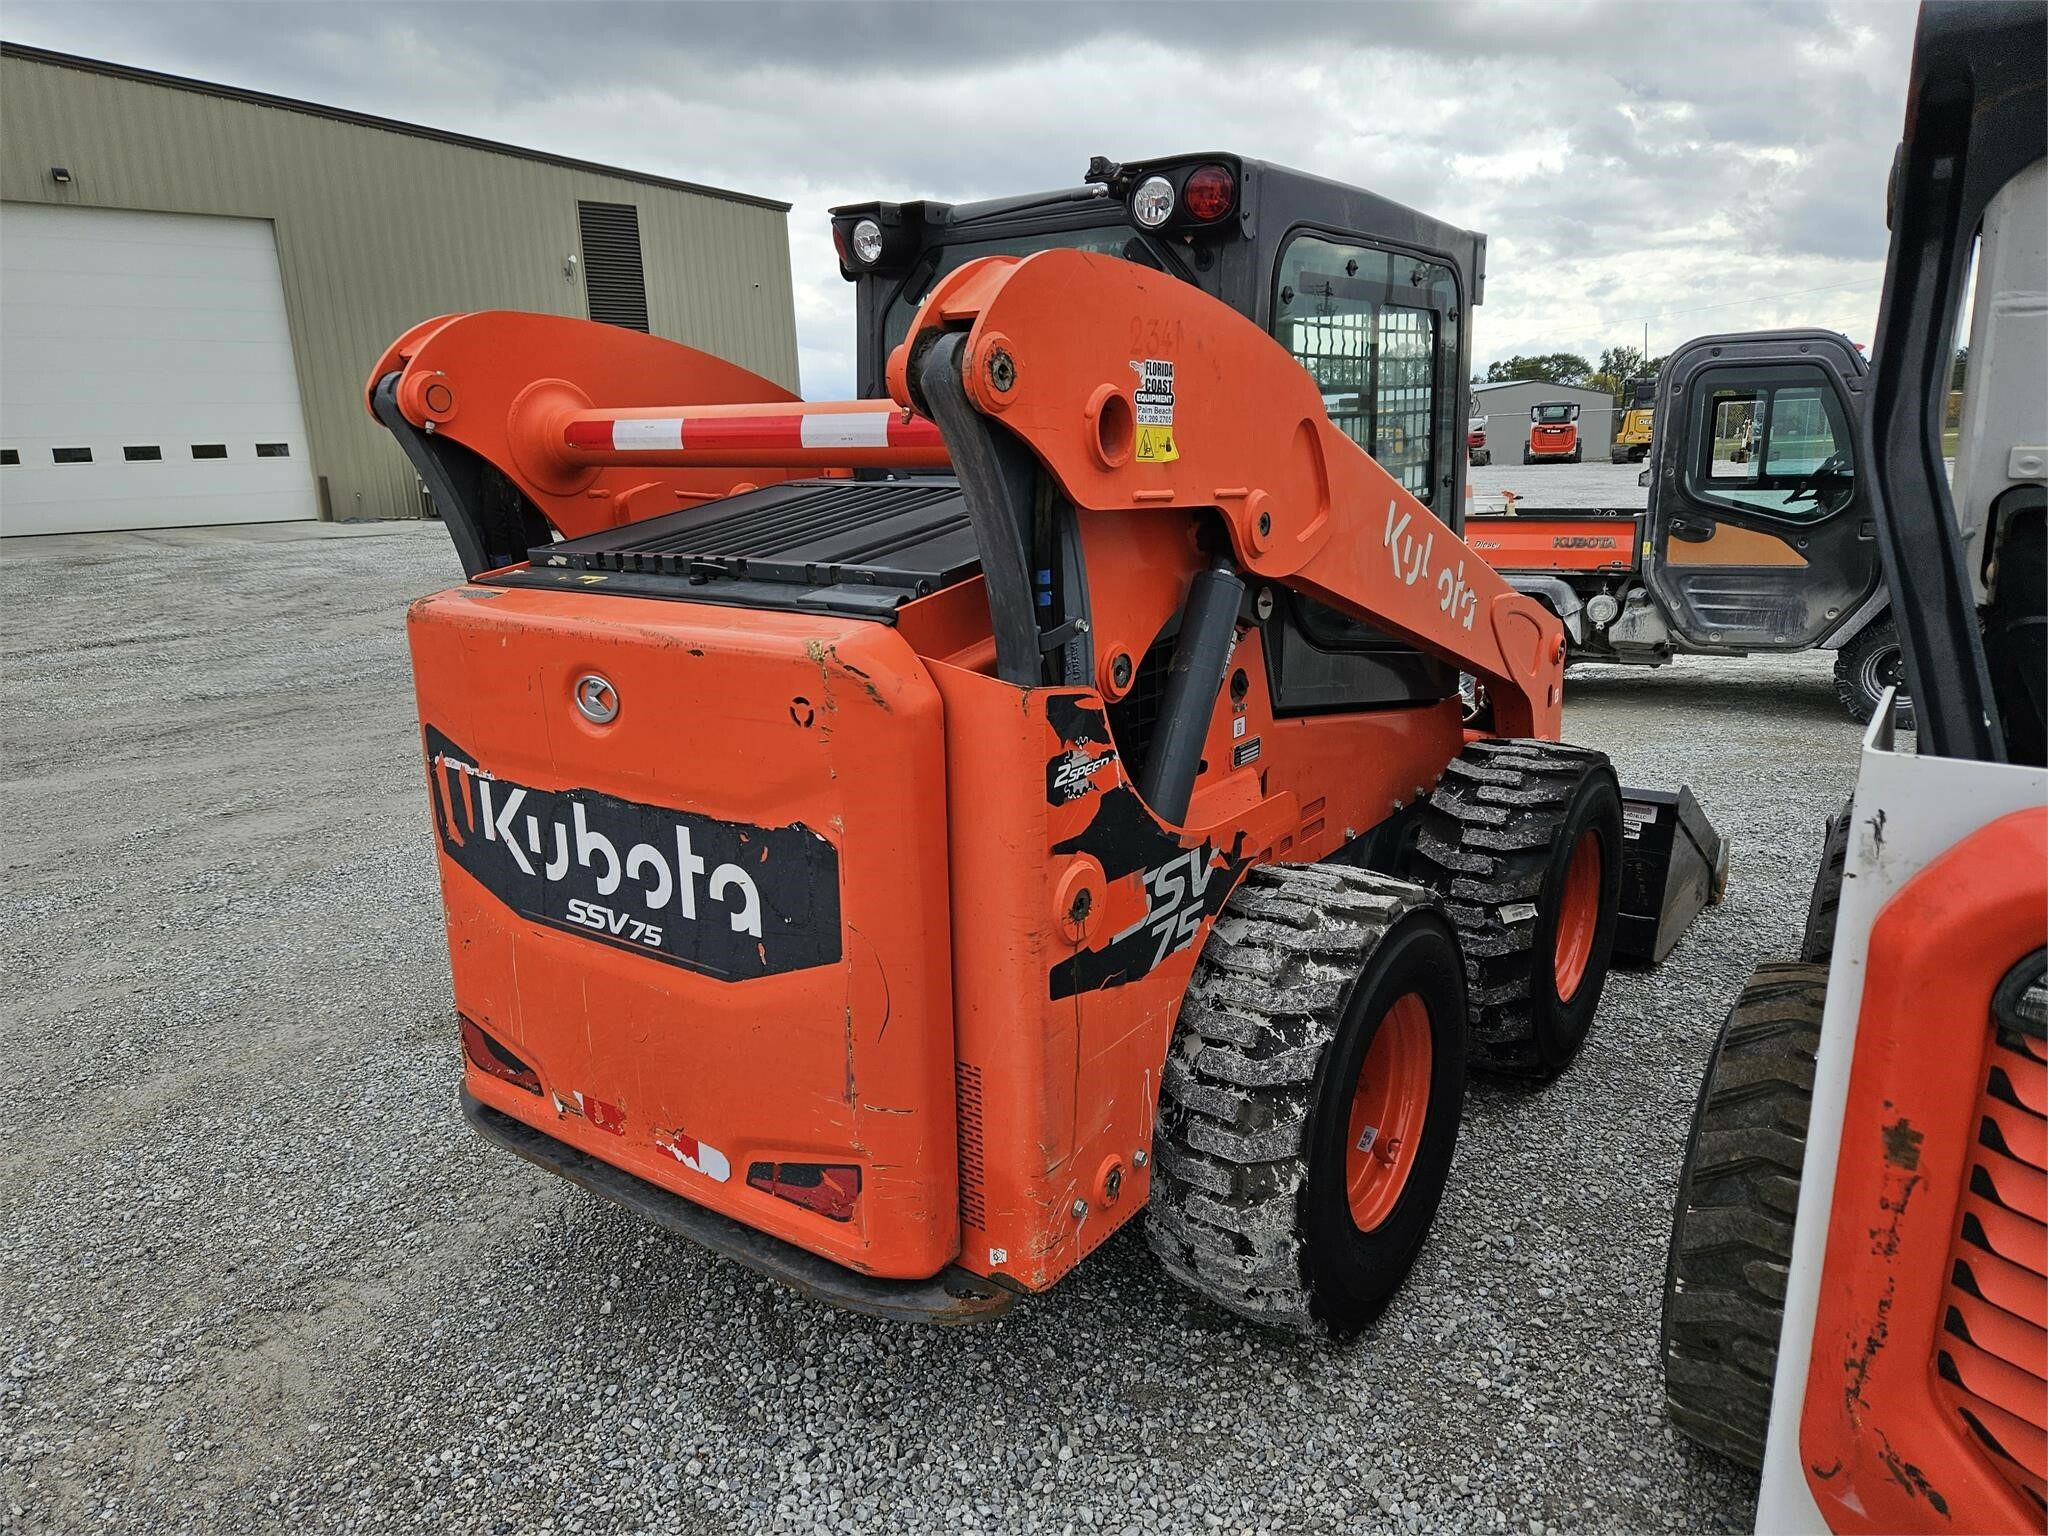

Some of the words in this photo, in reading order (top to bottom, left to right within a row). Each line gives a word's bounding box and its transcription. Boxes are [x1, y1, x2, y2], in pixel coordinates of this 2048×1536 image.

[1146, 361, 1173, 377] FLORIDA
[1145, 378, 1172, 394] COAST
[1136, 393, 1172, 404] EQUIPMENT
[1137, 405, 1153, 414] Palm
[1154, 406, 1172, 415] Beach
[1552, 536, 1617, 549] KUBOTA
[479, 780, 762, 939] Kubota
[1149, 898, 1205, 972] 75
